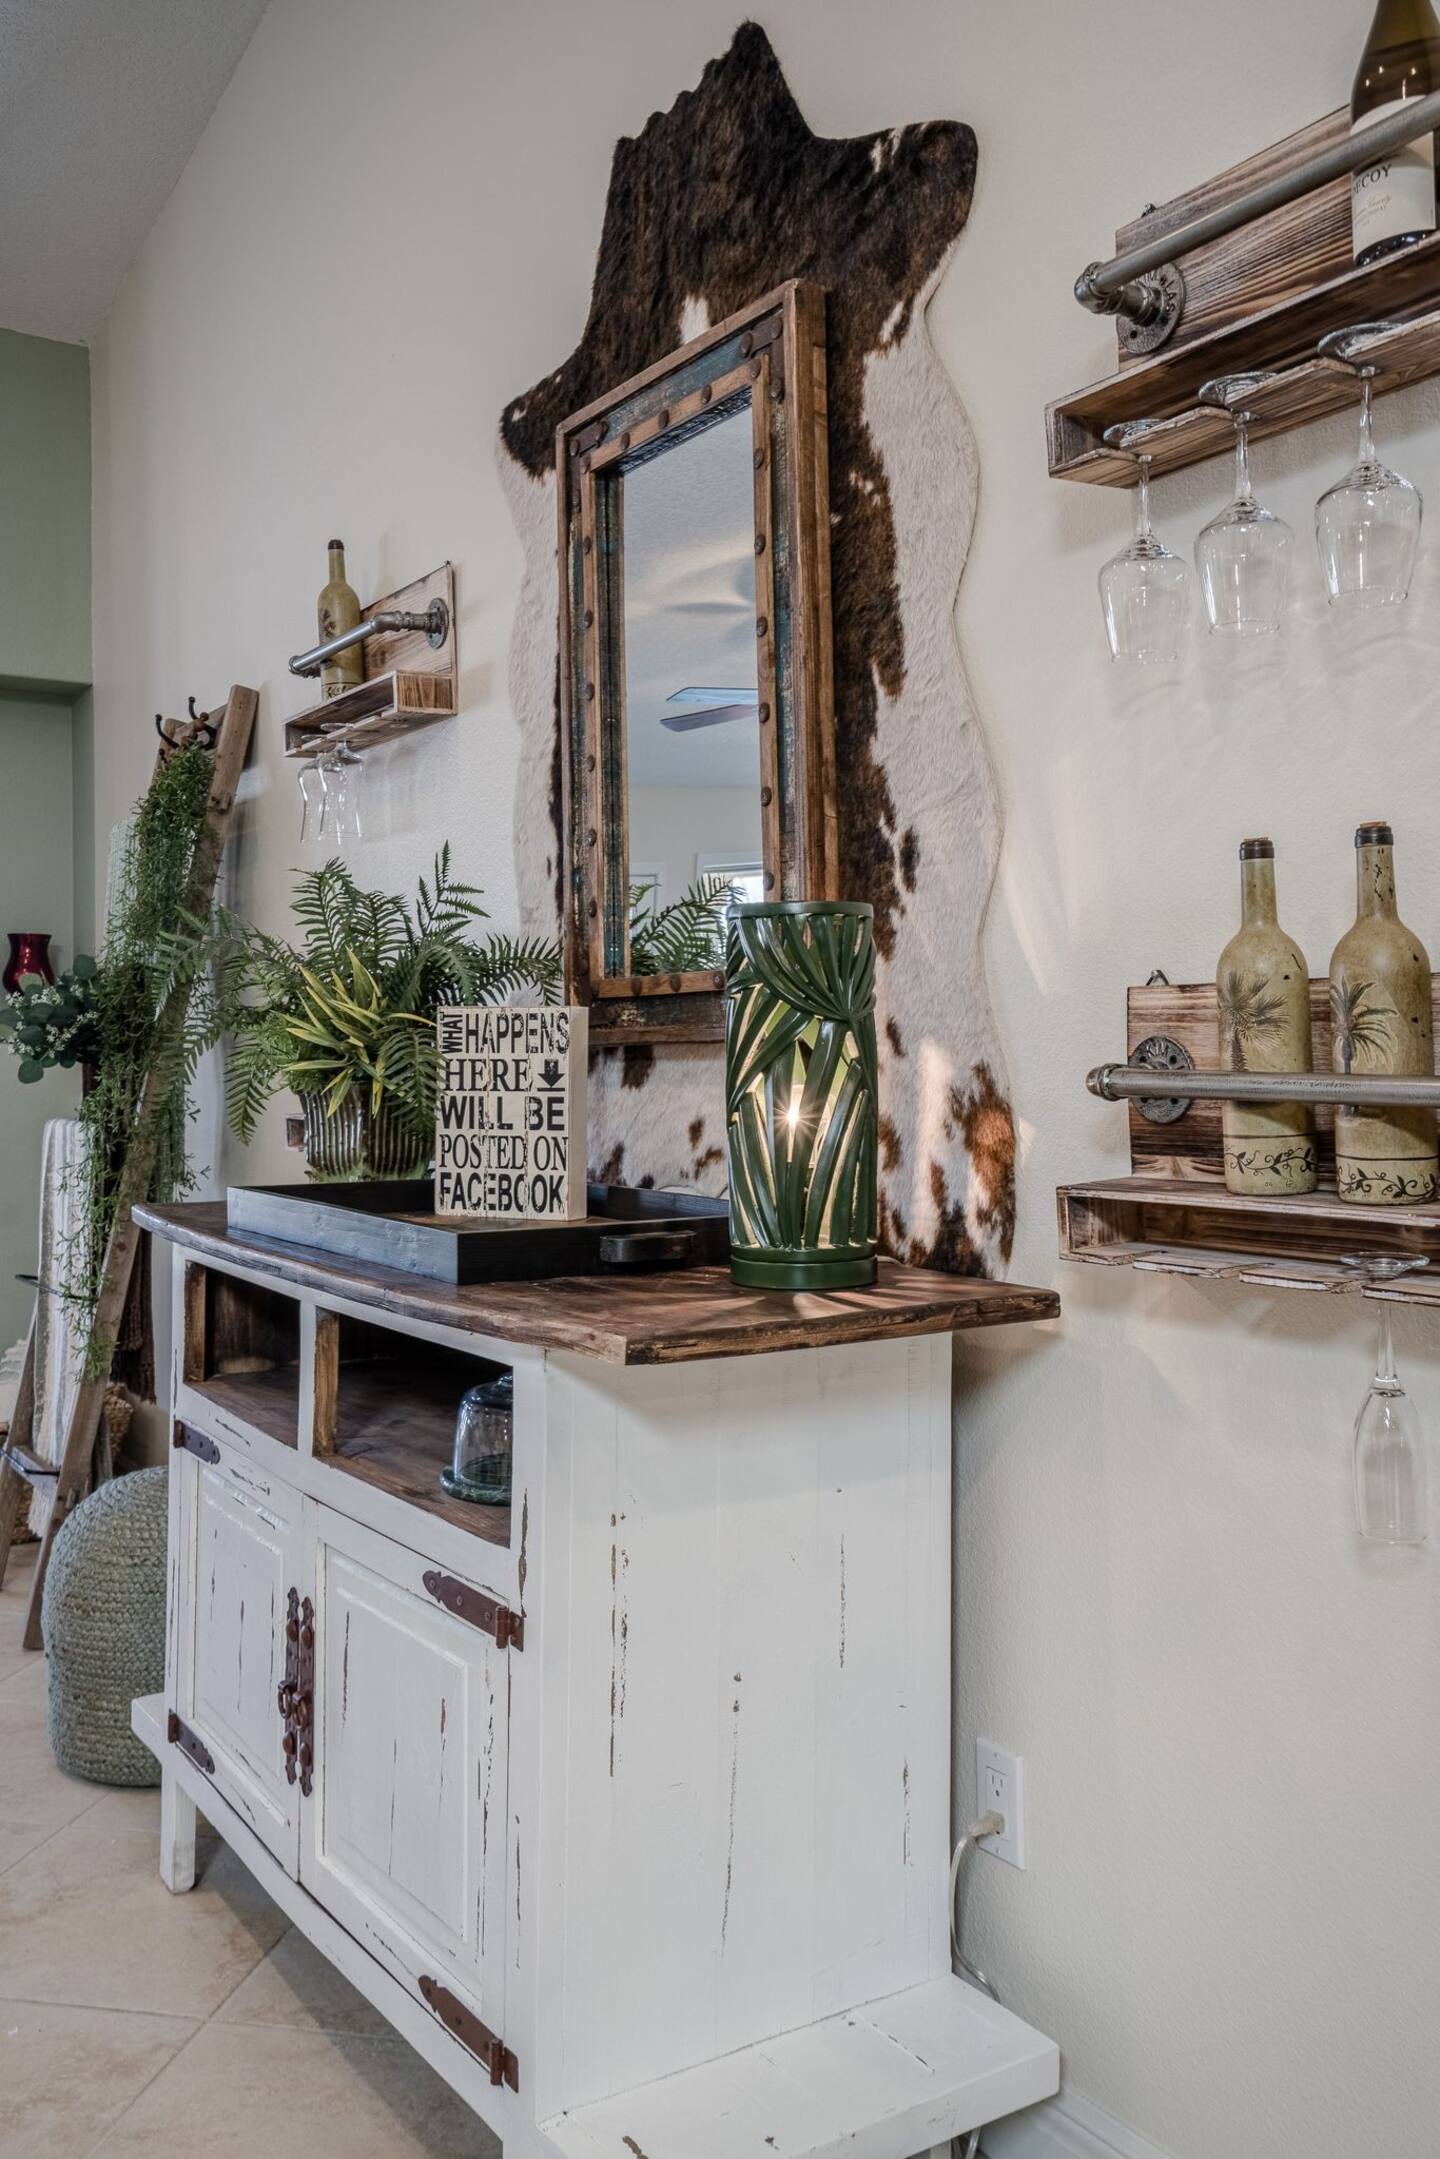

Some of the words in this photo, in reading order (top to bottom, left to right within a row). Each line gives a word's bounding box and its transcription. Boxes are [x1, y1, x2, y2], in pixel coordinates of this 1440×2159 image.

[441, 1011, 463, 1053] WHAT
[465, 1012, 569, 1054] HAPPENS
[445, 1058, 533, 1091] HERE
[440, 1096, 513, 1129] WILL
[525, 1096, 565, 1130] BE
[439, 1134, 526, 1170] POSTED
[533, 1135, 568, 1171] ON
[439, 1172, 564, 1213] FACEBOOK
